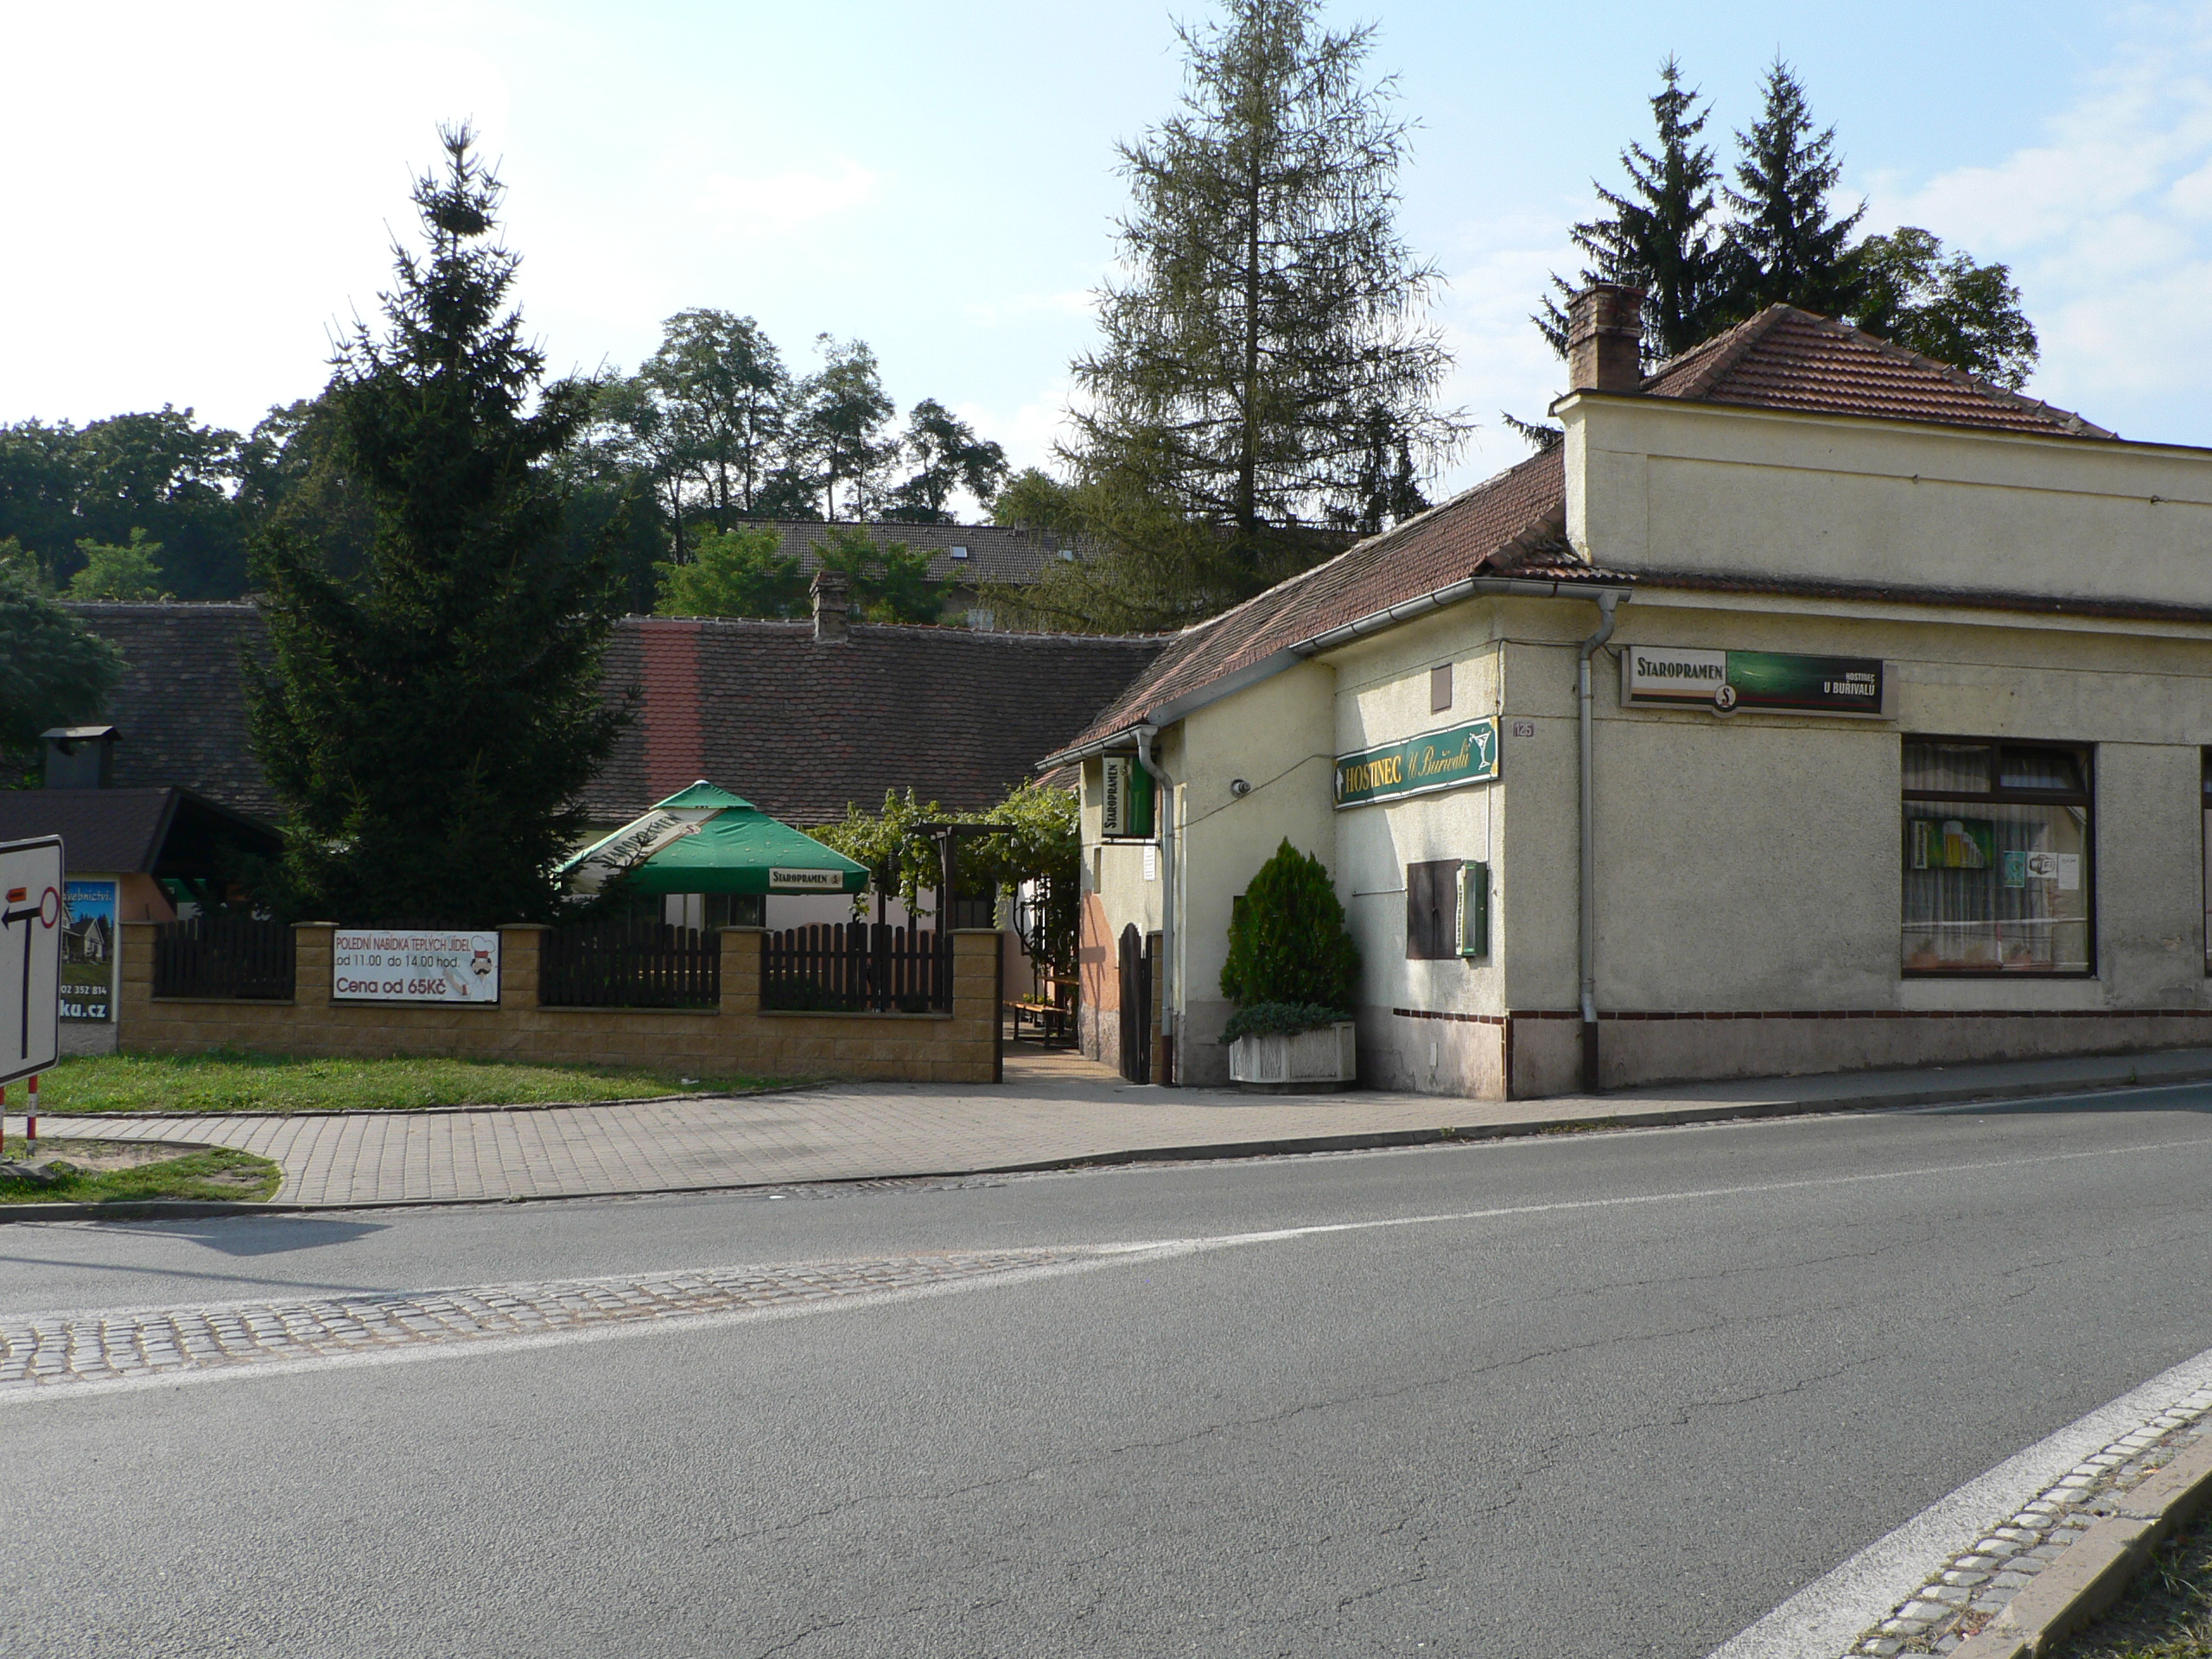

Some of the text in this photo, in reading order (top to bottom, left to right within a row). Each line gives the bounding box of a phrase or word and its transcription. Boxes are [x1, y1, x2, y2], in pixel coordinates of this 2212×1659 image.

[1637, 657, 1723, 680] STAROPRAMEN
[1846, 672, 1875, 683] HOSTINEC
[1823, 681, 1830, 693] U
[1515, 722, 1532, 736] 125
[1345, 754, 1402, 793] HOSTINEC
[1104, 764, 1118, 829] STAROPRAMEN
[773, 871, 828, 884] STAROPRAMEN
[336, 933, 471, 951] POLEDNÍ NABÍDKA TEPLÝCH JÍDEL
[336, 955, 461, 968] od 11.00 do 14.00 hod.
[74, 985, 90, 995] 352
[92, 986, 107, 995] 814
[336, 977, 447, 995] Cena od 65Kč
[60, 1000, 106, 1018] ku.cz
